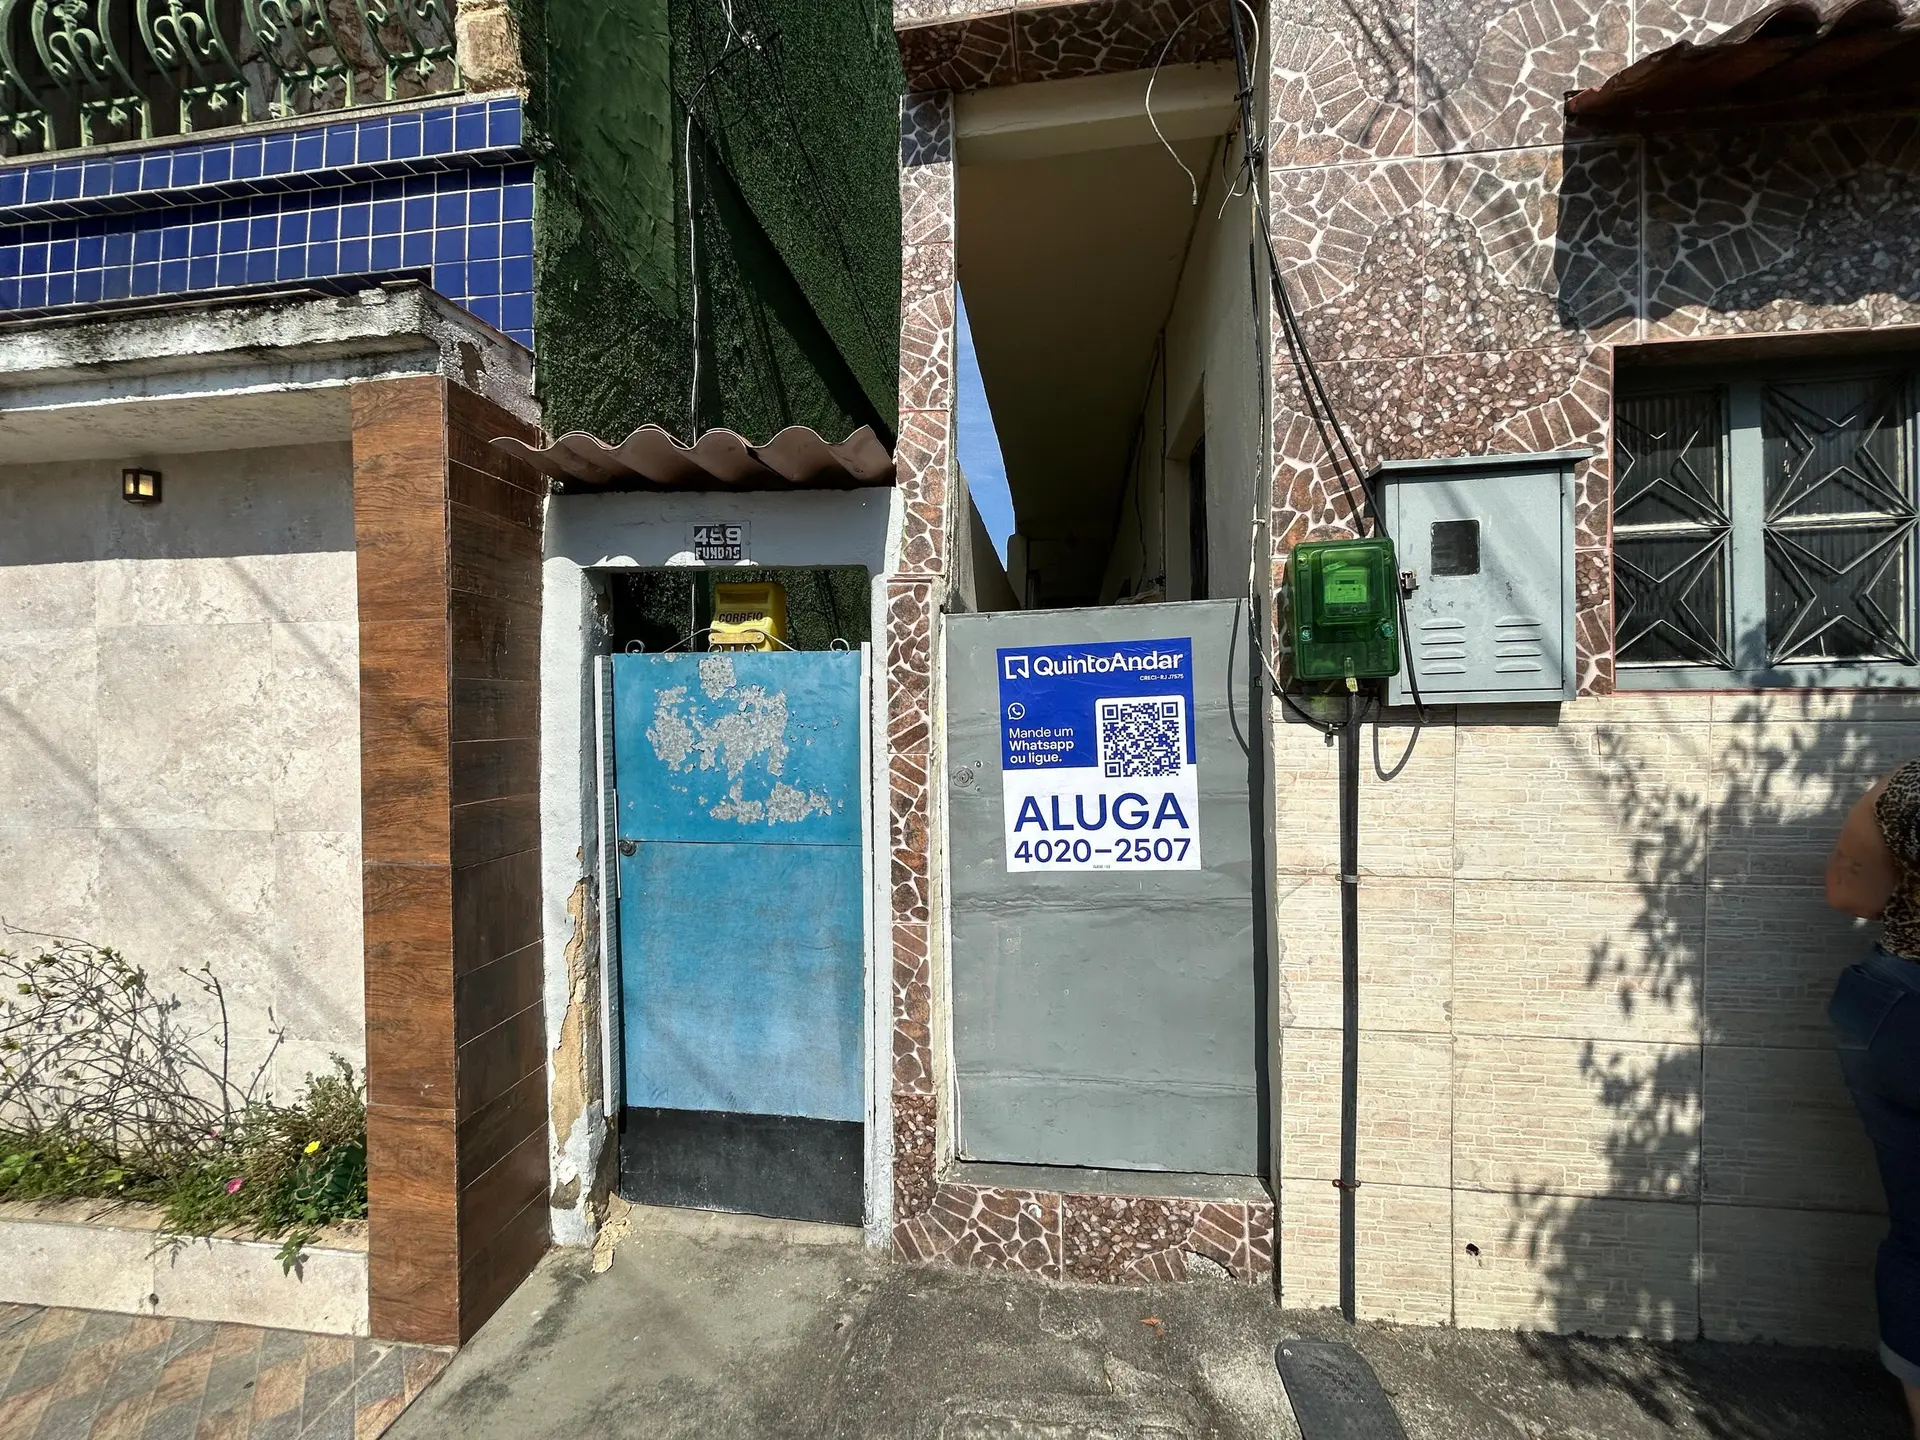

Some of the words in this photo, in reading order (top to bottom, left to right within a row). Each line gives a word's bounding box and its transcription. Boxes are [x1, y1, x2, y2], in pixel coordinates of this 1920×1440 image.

[694, 527, 741, 546] 459
[695, 546, 740, 560] FUNDOS
[1033, 651, 1184, 677] QuintoAndar
[1009, 726, 1051, 739] Mande
[1054, 727, 1074, 738] um
[1009, 739, 1075, 752] Whatsapp
[1010, 754, 1026, 764] ou
[1028, 752, 1062, 766] ligue.
[1013, 792, 1190, 833] ALUGA
[1014, 837, 1191, 864] 4020-2507
